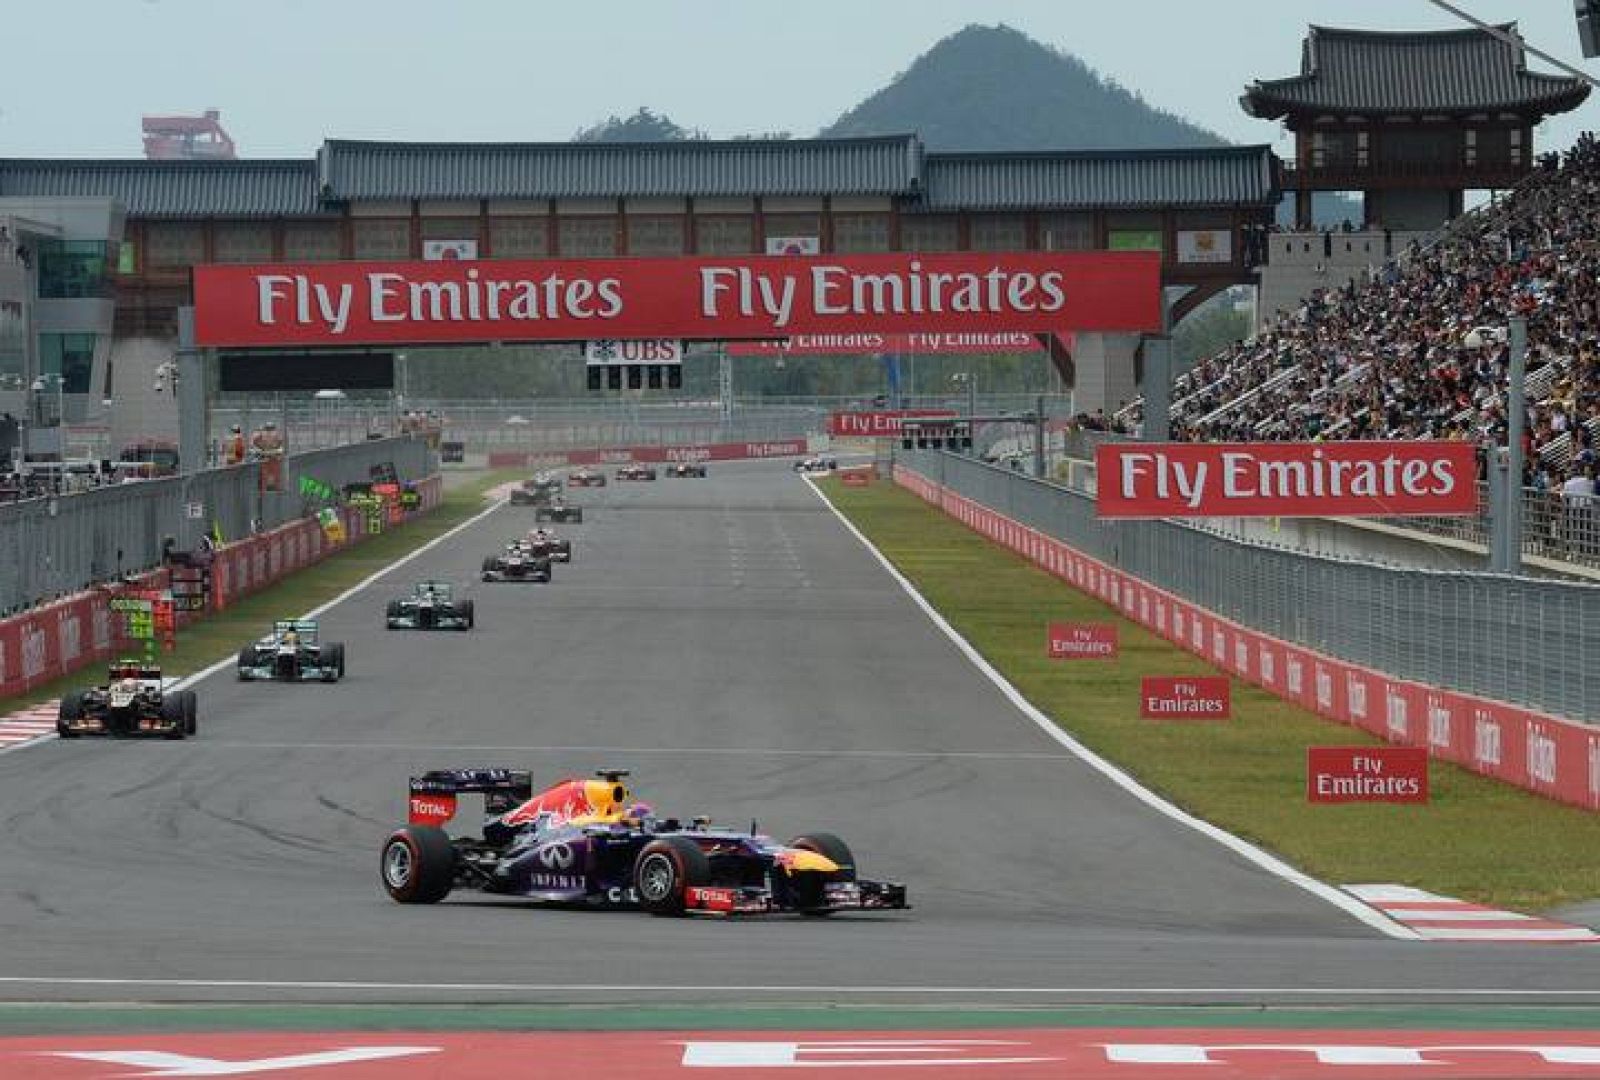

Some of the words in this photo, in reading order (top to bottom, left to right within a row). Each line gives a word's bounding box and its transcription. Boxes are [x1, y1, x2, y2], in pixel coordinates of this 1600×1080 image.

[256, 273, 352, 334] Fly
[367, 268, 623, 322] Emirates
[700, 266, 796, 326] Fly
[811, 262, 1066, 315] Emirates
[622, 339, 675, 361] UBS
[1119, 453, 1208, 507] Fly
[1221, 448, 1455, 498] Emirates
[1148, 697, 1223, 712] Emirates
[1352, 757, 1383, 774] Fly
[1317, 773, 1419, 795] Emirates
